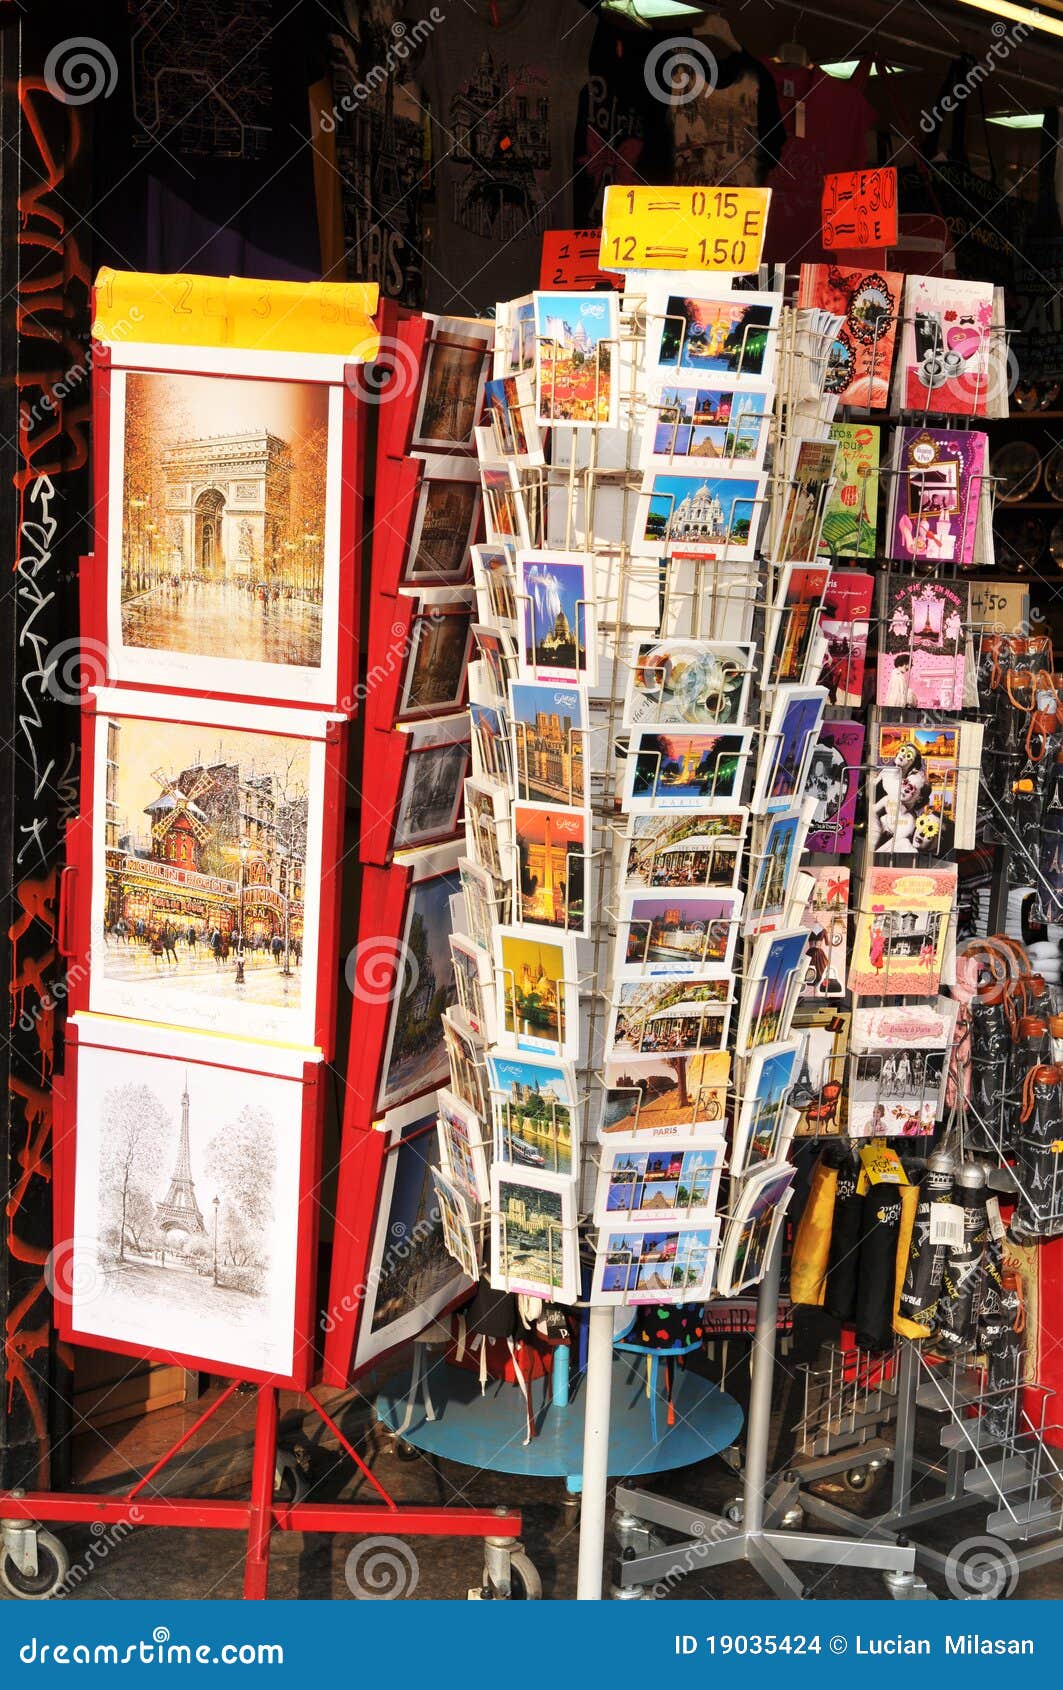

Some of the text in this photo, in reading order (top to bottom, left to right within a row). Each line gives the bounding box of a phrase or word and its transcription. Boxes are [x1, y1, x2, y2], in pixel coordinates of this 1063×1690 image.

[626, 190, 635, 215] 1
[691, 193, 739, 219] 0,15
[744, 211, 760, 236] E
[612, 237, 637, 261] 12
[698, 239, 746, 265] 1,50
[652, 1126, 678, 1137] PARIS
